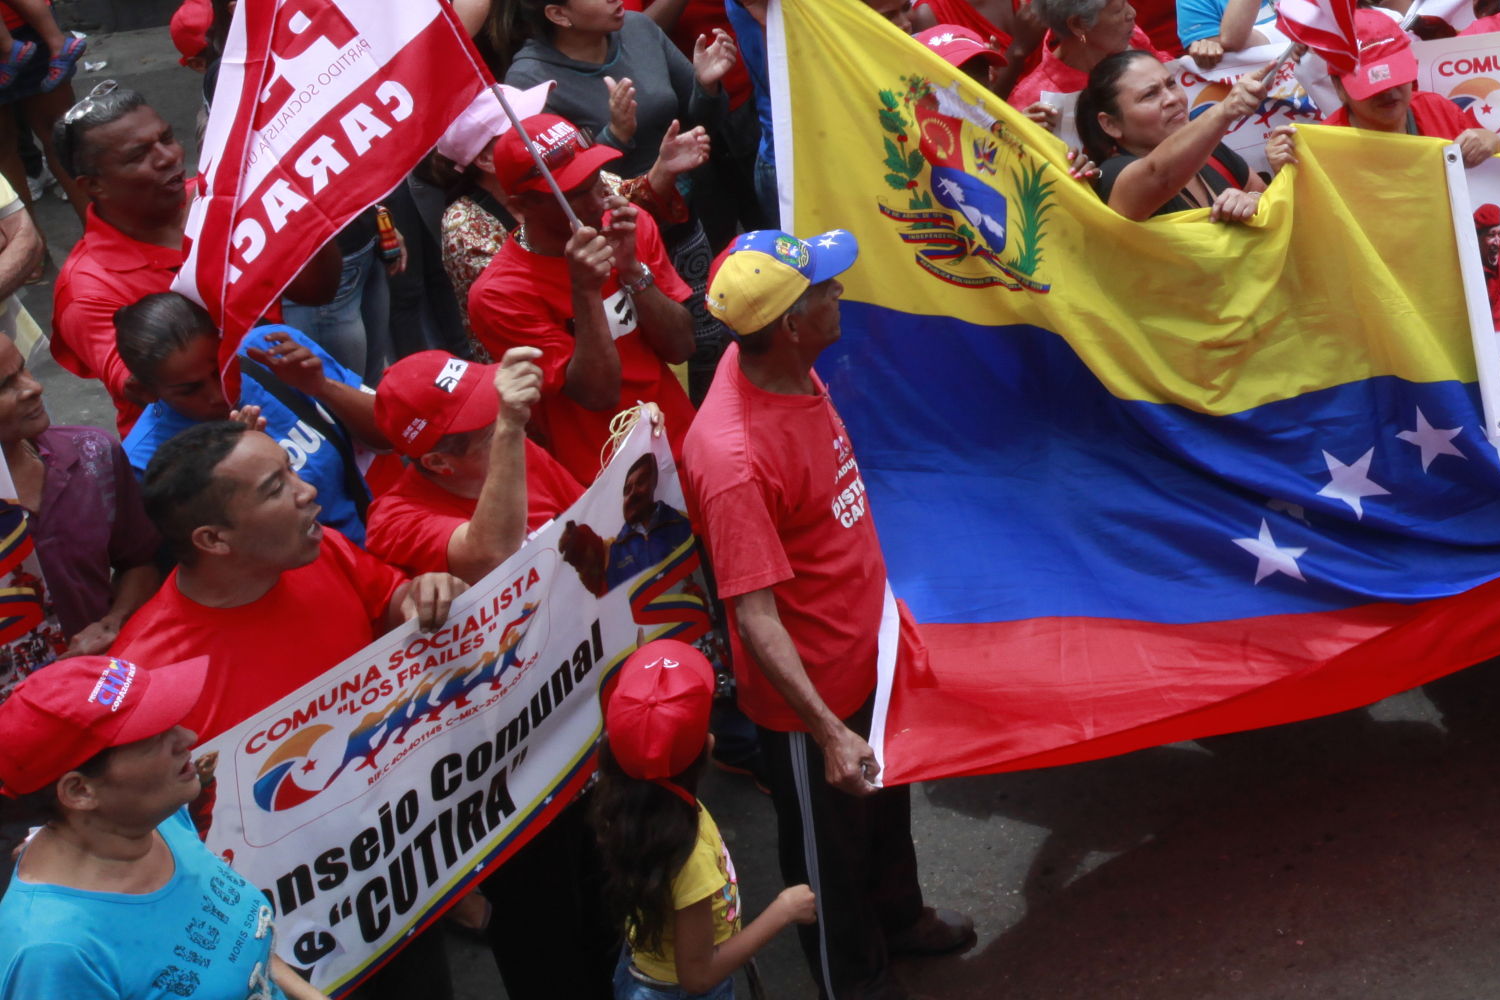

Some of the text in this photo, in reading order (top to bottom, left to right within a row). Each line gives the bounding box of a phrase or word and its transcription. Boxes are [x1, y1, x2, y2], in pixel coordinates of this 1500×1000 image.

[244, 566, 541, 754] COMUNA SOCIALISTA
[430, 617, 605, 803] Comunal
[227, 899, 261, 964] MORIS SONIA
